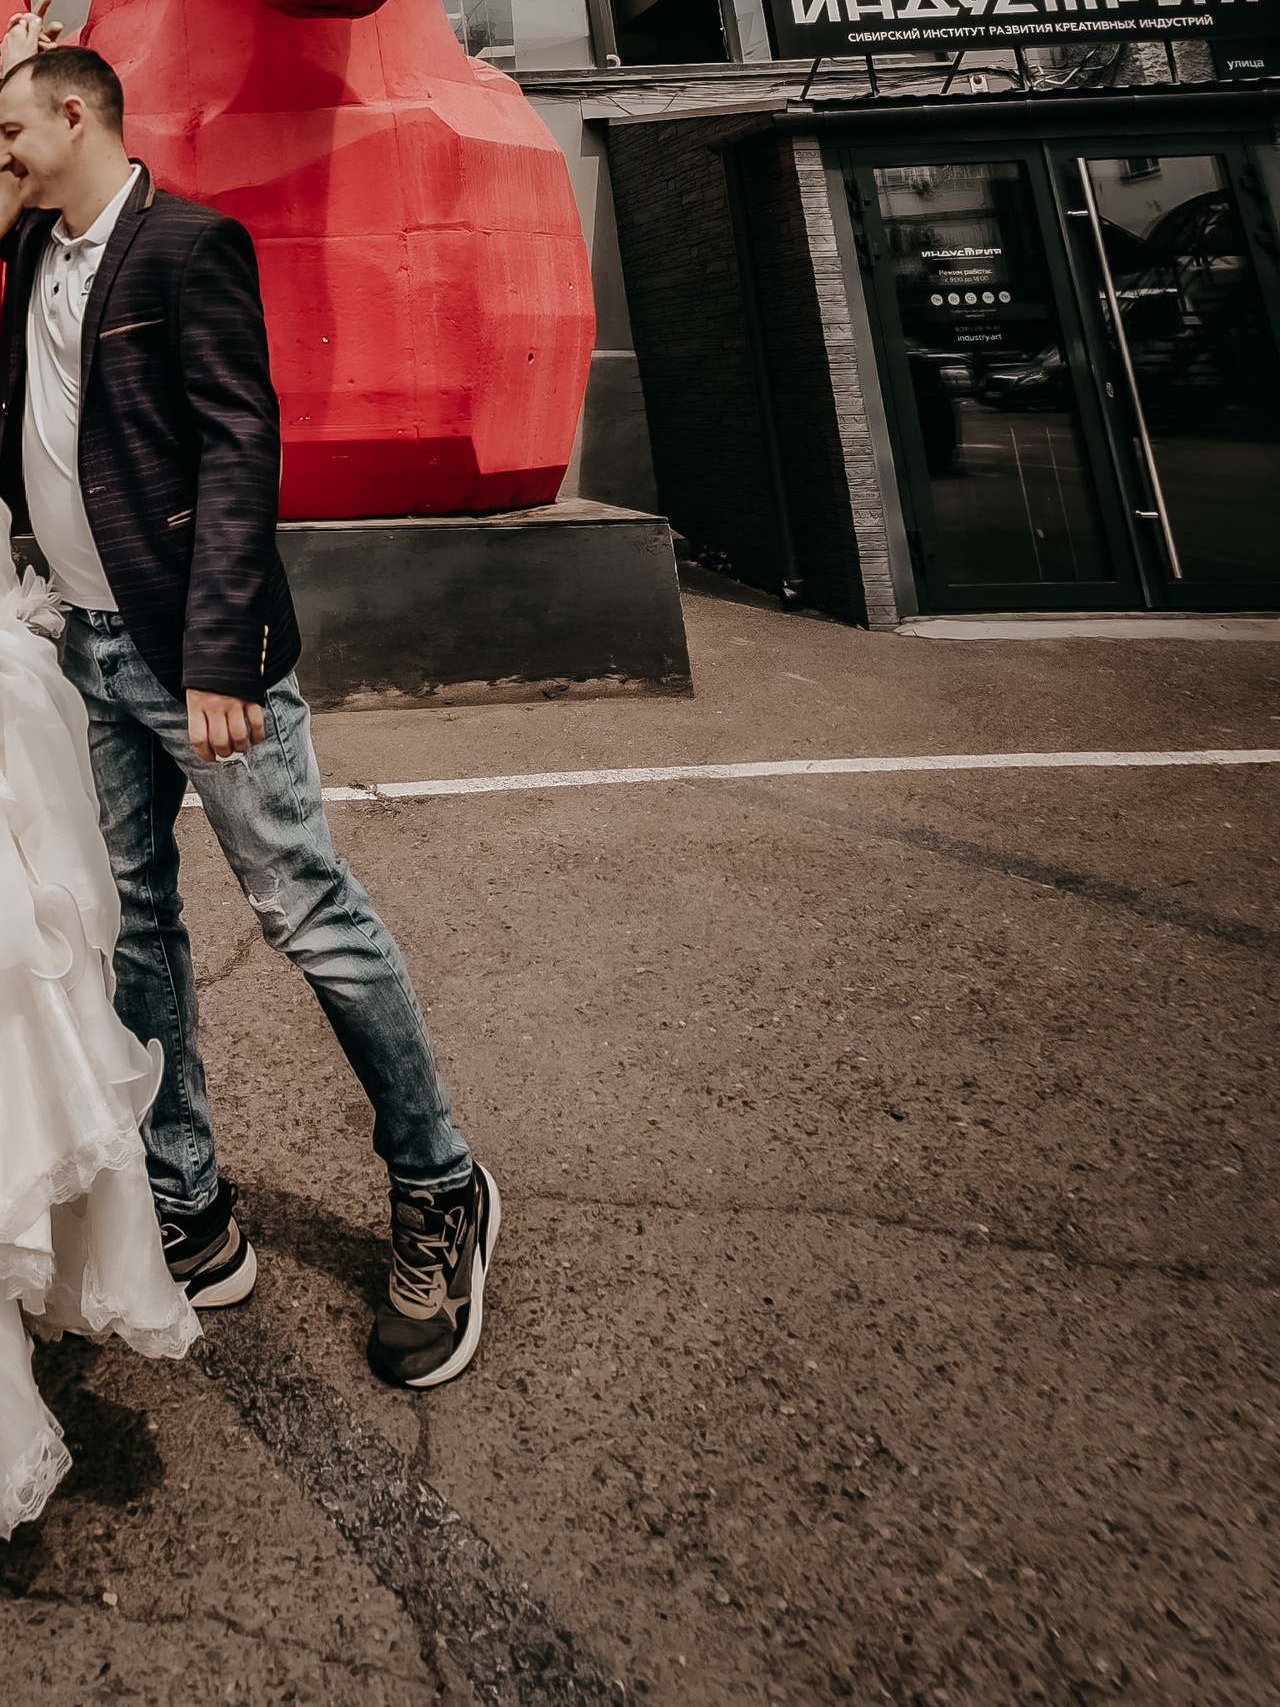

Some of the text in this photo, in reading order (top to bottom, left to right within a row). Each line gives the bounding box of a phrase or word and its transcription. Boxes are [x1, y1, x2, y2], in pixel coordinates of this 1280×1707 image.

[847, 14, 1214, 43] СИБИРСКИЙ ИНСТИТУТ РАЗВИТИЯ КРЕАТИВНЫХ ИНДУСТРИЙ
[1226, 58, 1265, 71] улица
[956, 333, 1003, 343] industry.art
